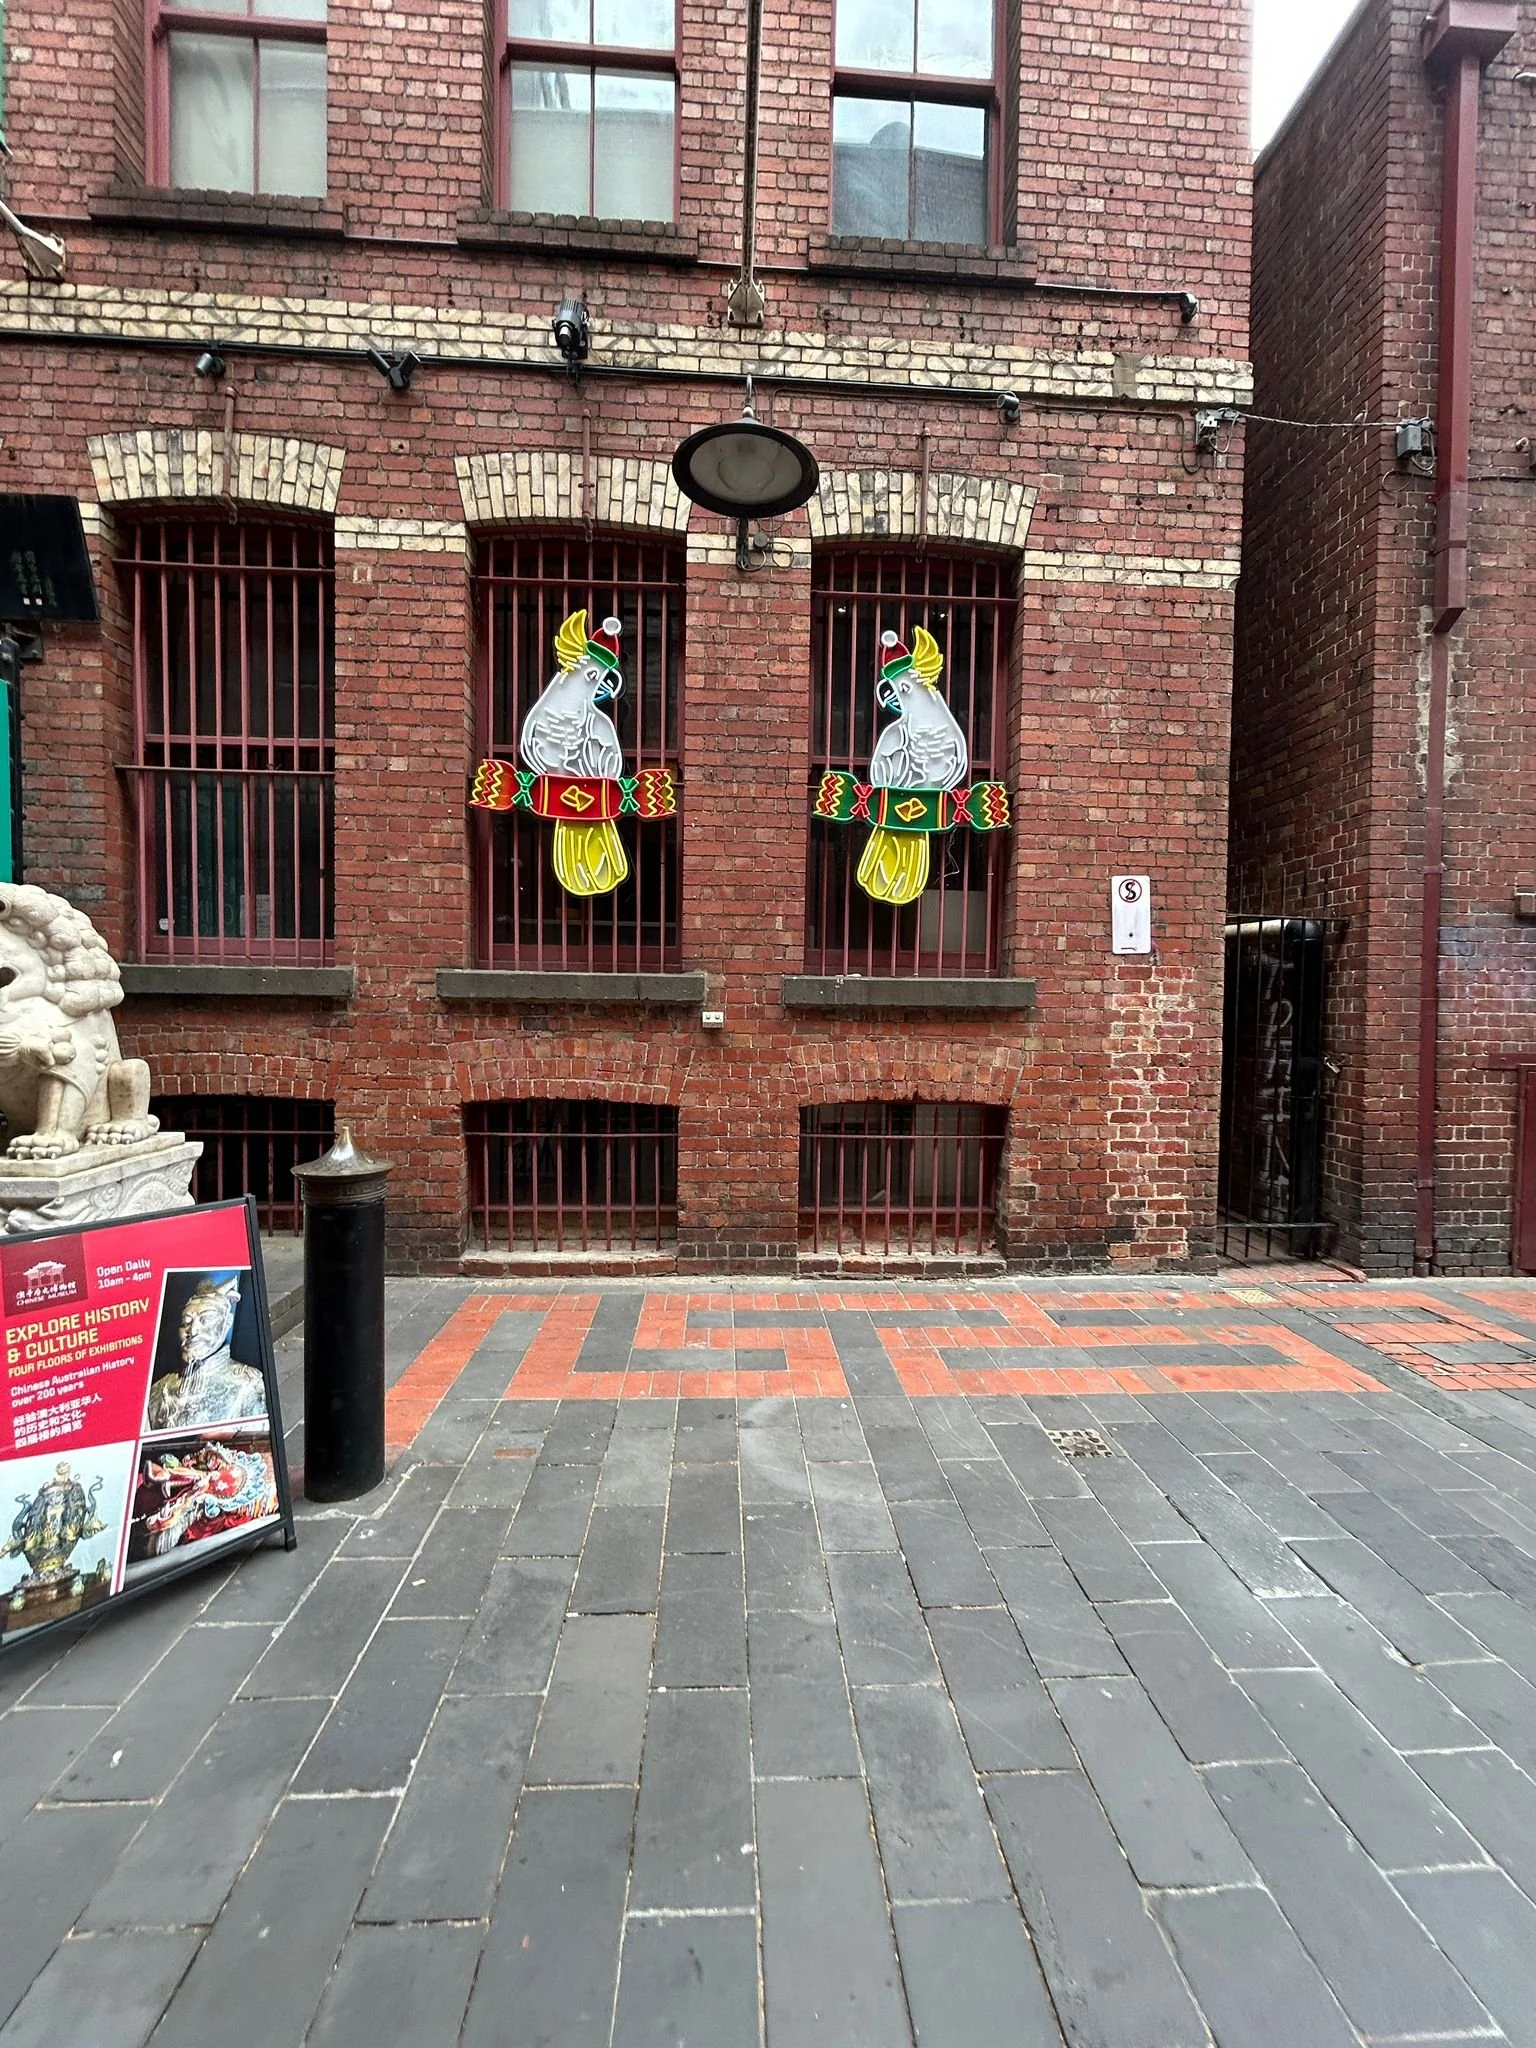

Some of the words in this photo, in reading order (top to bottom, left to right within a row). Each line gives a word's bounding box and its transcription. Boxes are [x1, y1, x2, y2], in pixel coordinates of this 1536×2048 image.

[96, 1263, 123, 1278] Open
[125, 1258, 151, 1273] Daily
[97, 1278, 124, 1290] 10am
[132, 1271, 152, 1282] 4pm
[47, 1288, 77, 1300] MUSEUM
[5, 1313, 81, 1345] EXPLORE
[84, 1297, 150, 1327] HISTORY
[7, 1347, 21, 1364] &
[25, 1327, 99, 1360] CULTURE
[8, 1362, 35, 1379] FOUR
[37, 1353, 74, 1371] FLOORS
[75, 1348, 87, 1361] OF
[89, 1334, 144, 1357] EXHIBITIONS
[10, 1378, 51, 1398] Chinese
[51, 1365, 101, 1386] Australian
[102, 1355, 136, 1372] History
[11, 1395, 35, 1409] over
[36, 1387, 56, 1401] 200
[57, 1380, 85, 1396] years
